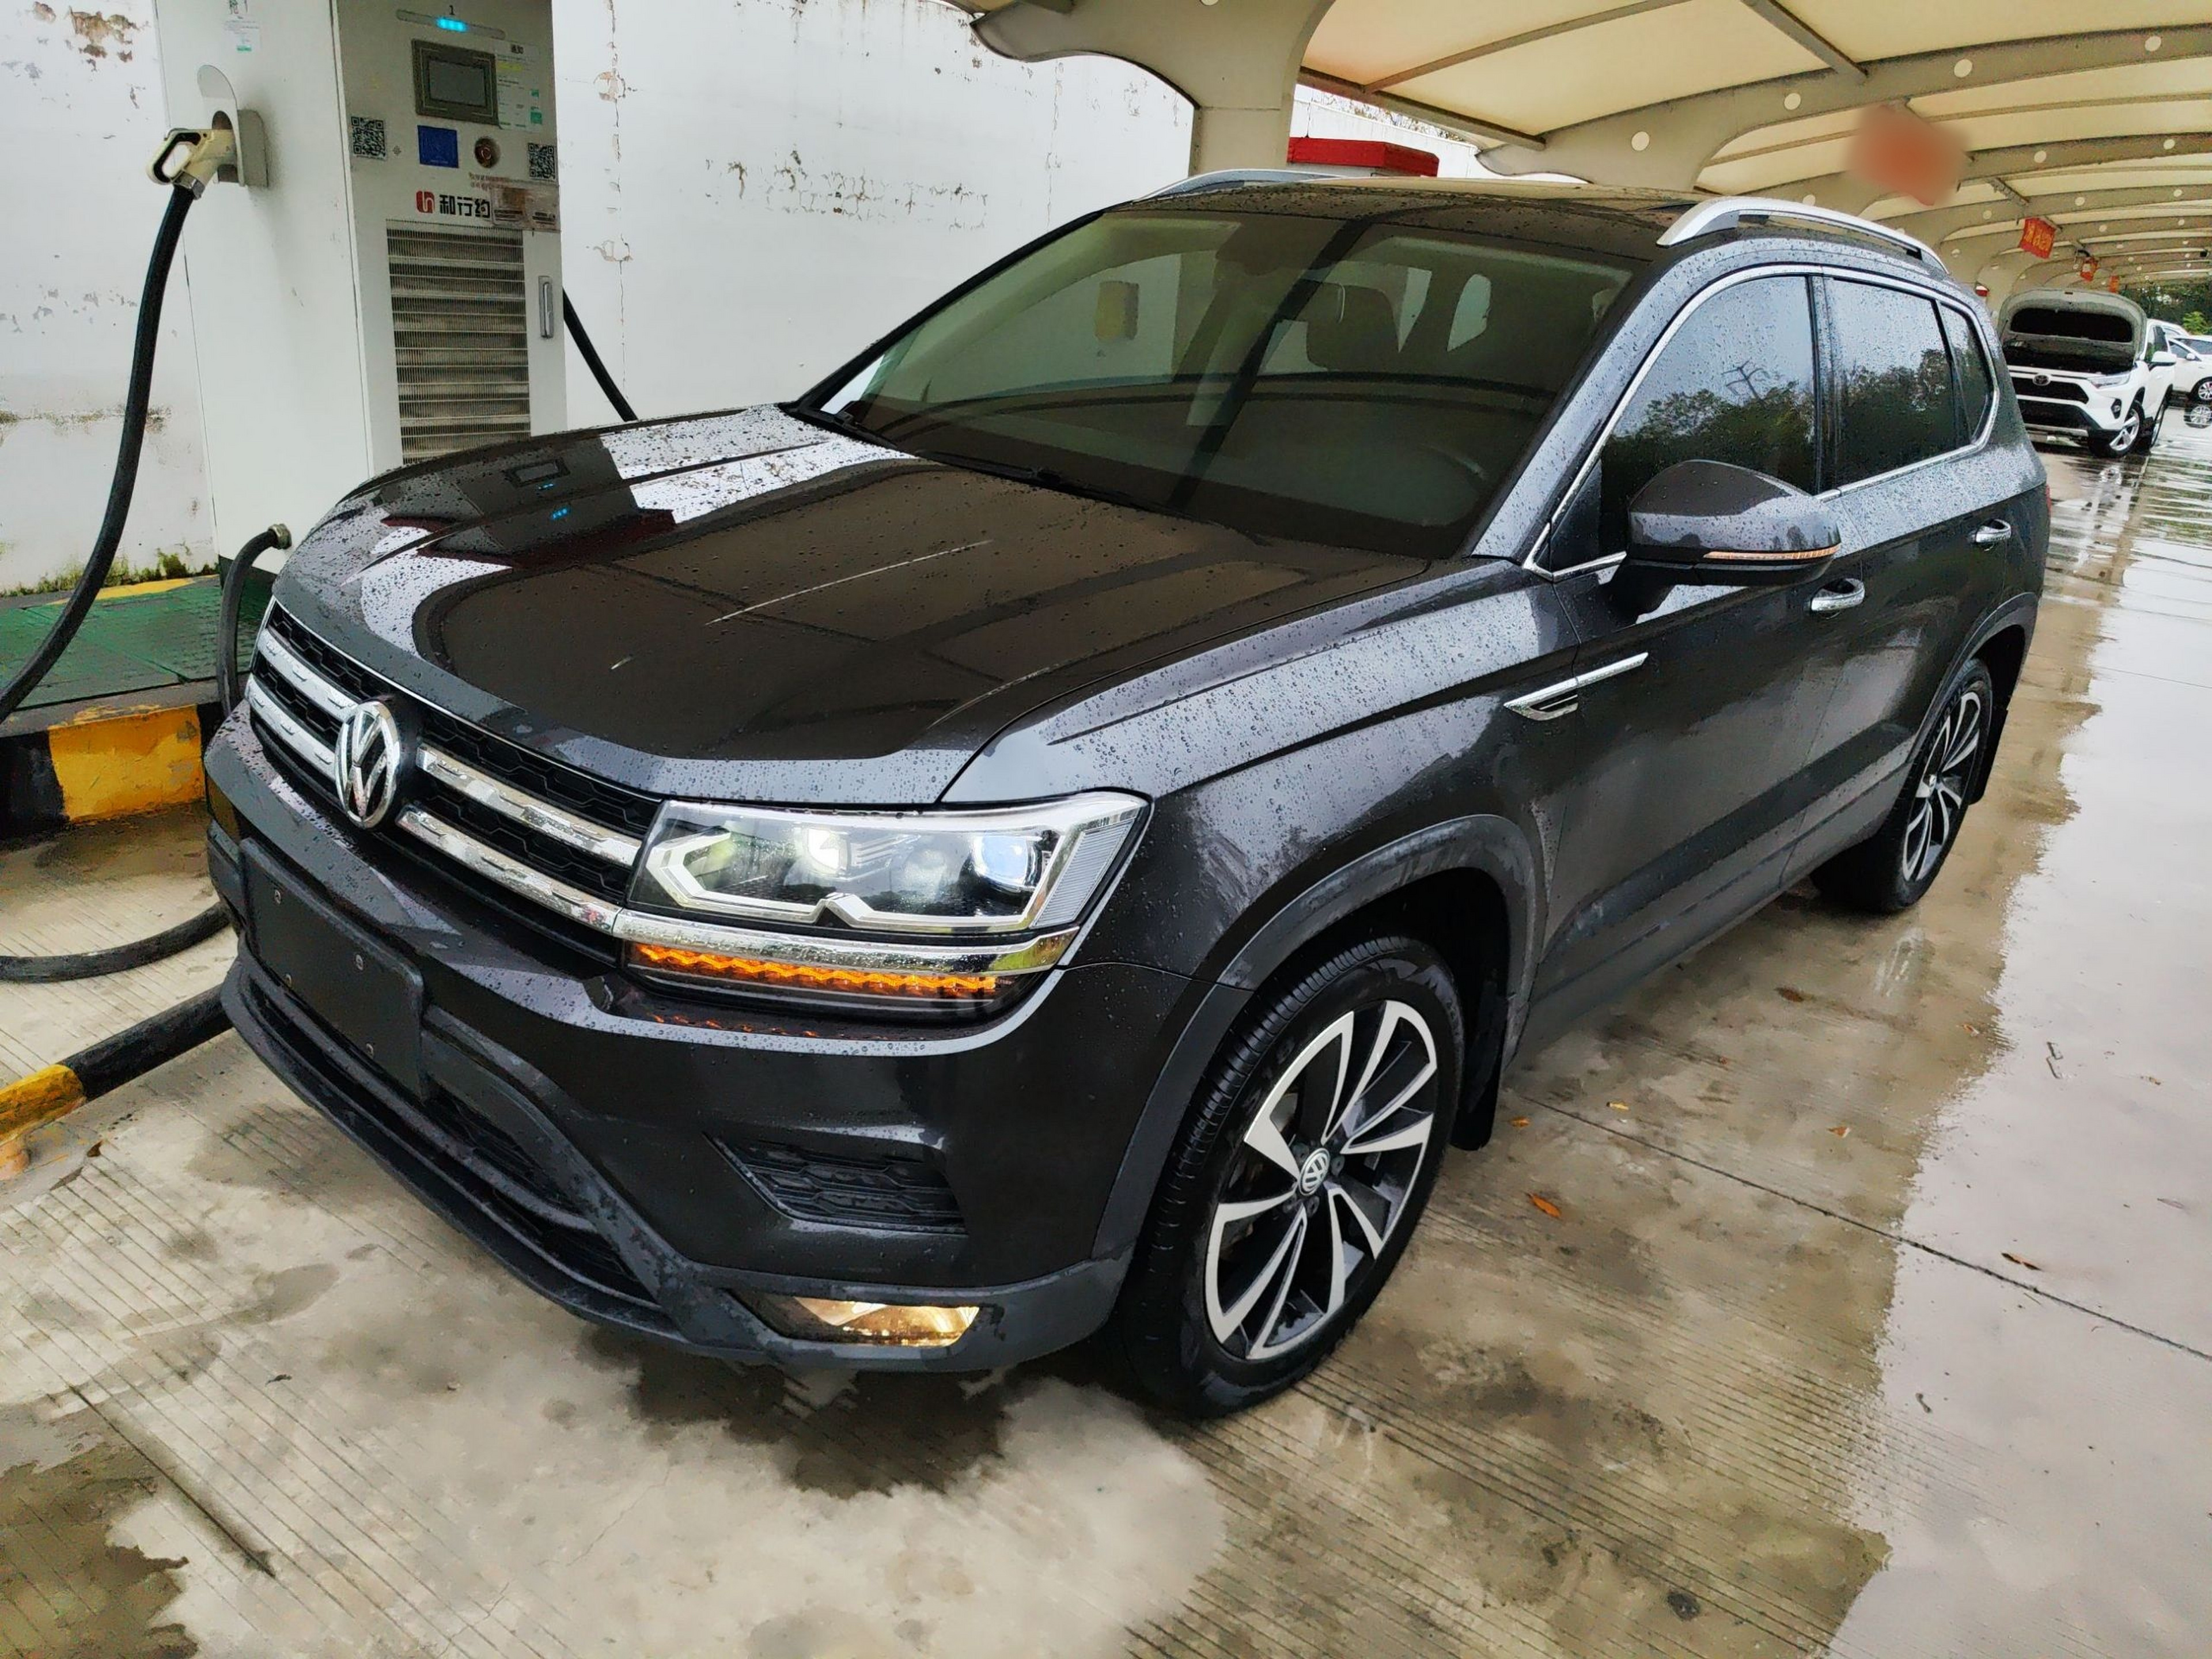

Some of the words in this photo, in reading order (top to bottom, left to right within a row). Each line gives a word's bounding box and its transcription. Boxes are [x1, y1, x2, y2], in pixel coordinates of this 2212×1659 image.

[449, 5, 454, 15] 1
[439, 194, 490, 218] 和行约
